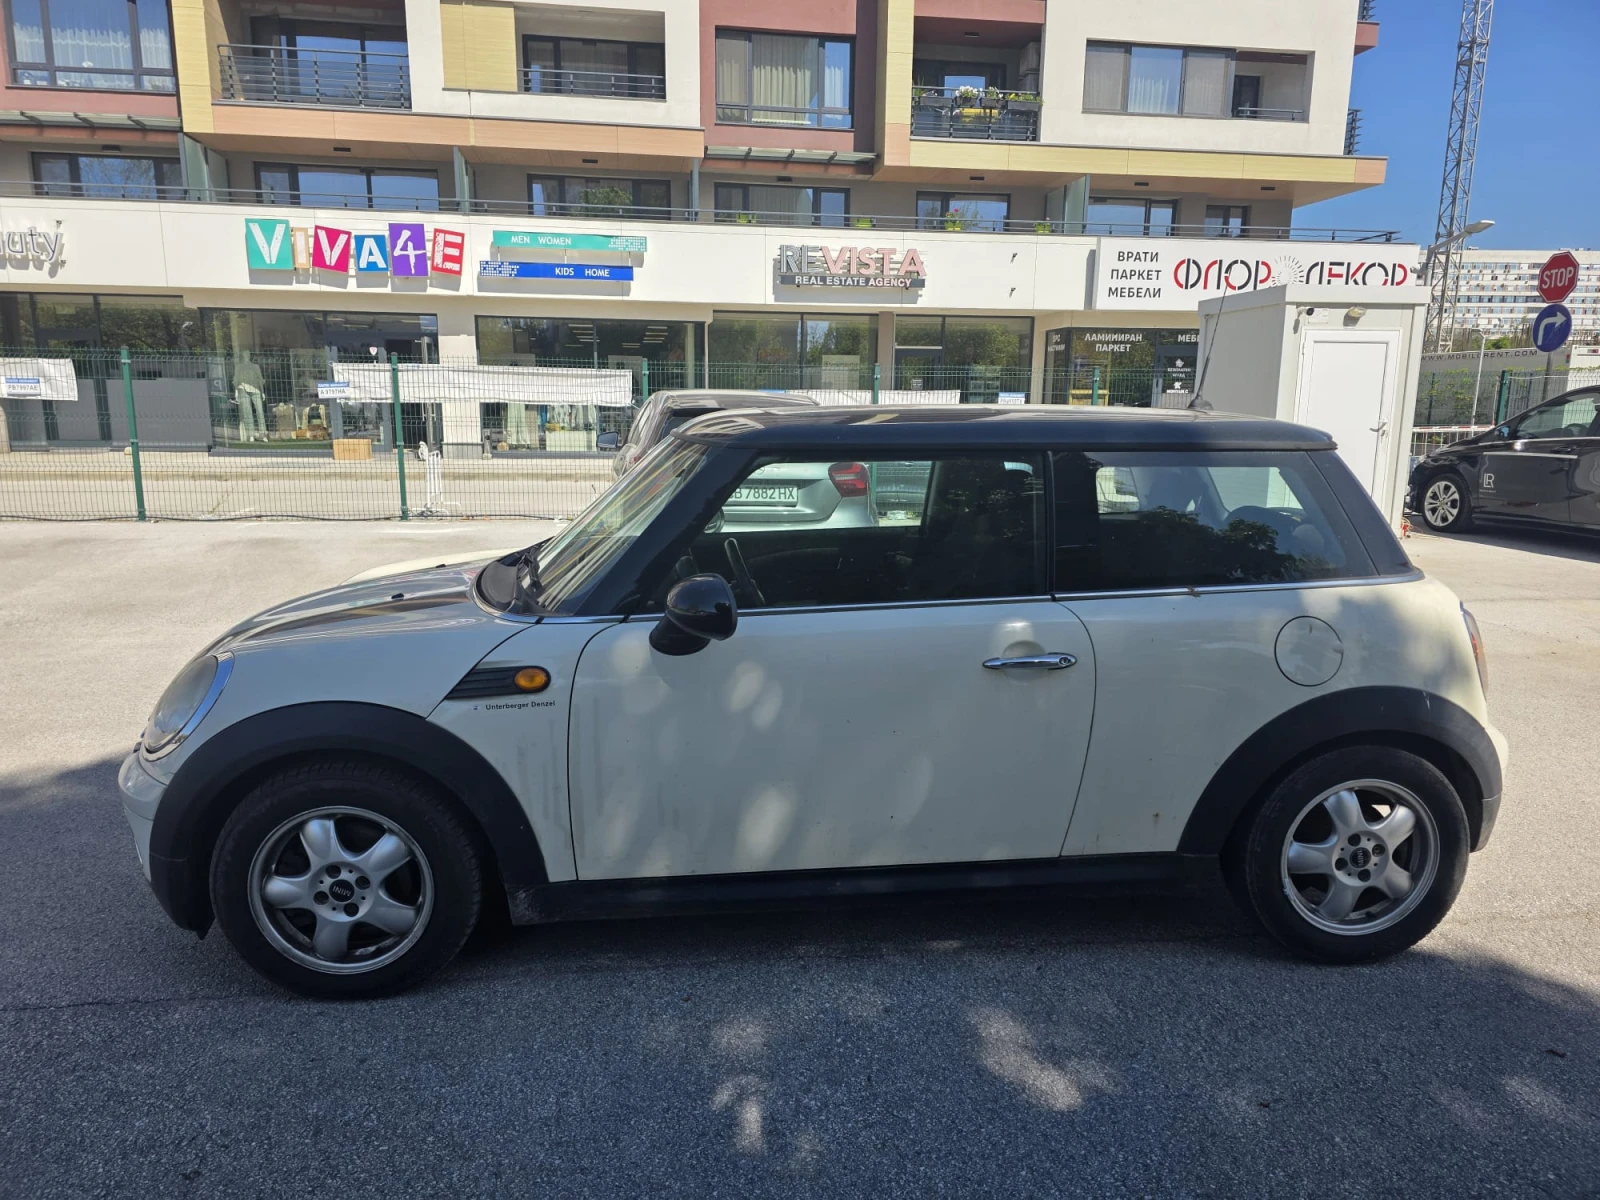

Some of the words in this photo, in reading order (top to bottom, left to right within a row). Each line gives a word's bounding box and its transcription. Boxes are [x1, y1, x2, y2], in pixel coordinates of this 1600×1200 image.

[0, 228, 60, 262] uty
[511, 235, 530, 245] MEN
[538, 236, 572, 246] WOMEN
[248, 222, 462, 275] VIVA4E
[779, 244, 927, 276] REVISTA
[1117, 250, 1159, 262] ВРАТИ
[555, 267, 574, 276] KIDS
[585, 268, 610, 277] HOME
[1110, 268, 1162, 281] ПАРКЕТ
[1173, 258, 1272, 291] ФЛОР
[1541, 266, 1575, 289] STOP
[795, 276, 823, 285] REAL
[826, 276, 866, 286] ESTATE
[868, 277, 912, 287] AGENCY
[1108, 287, 1162, 298] МЕБЕЛИ
[1084, 333, 1142, 342] ЛАМИНИРАН
[1177, 334, 1199, 342] МЕБ
[1095, 343, 1131, 352] ПАРКЕТ
[745, 486, 776, 499] 7882
[779, 486, 795, 500] HX
[485, 701, 529, 710] Unterberger
[531, 700, 556, 708] Denzel
[332, 885, 352, 897] MINI
